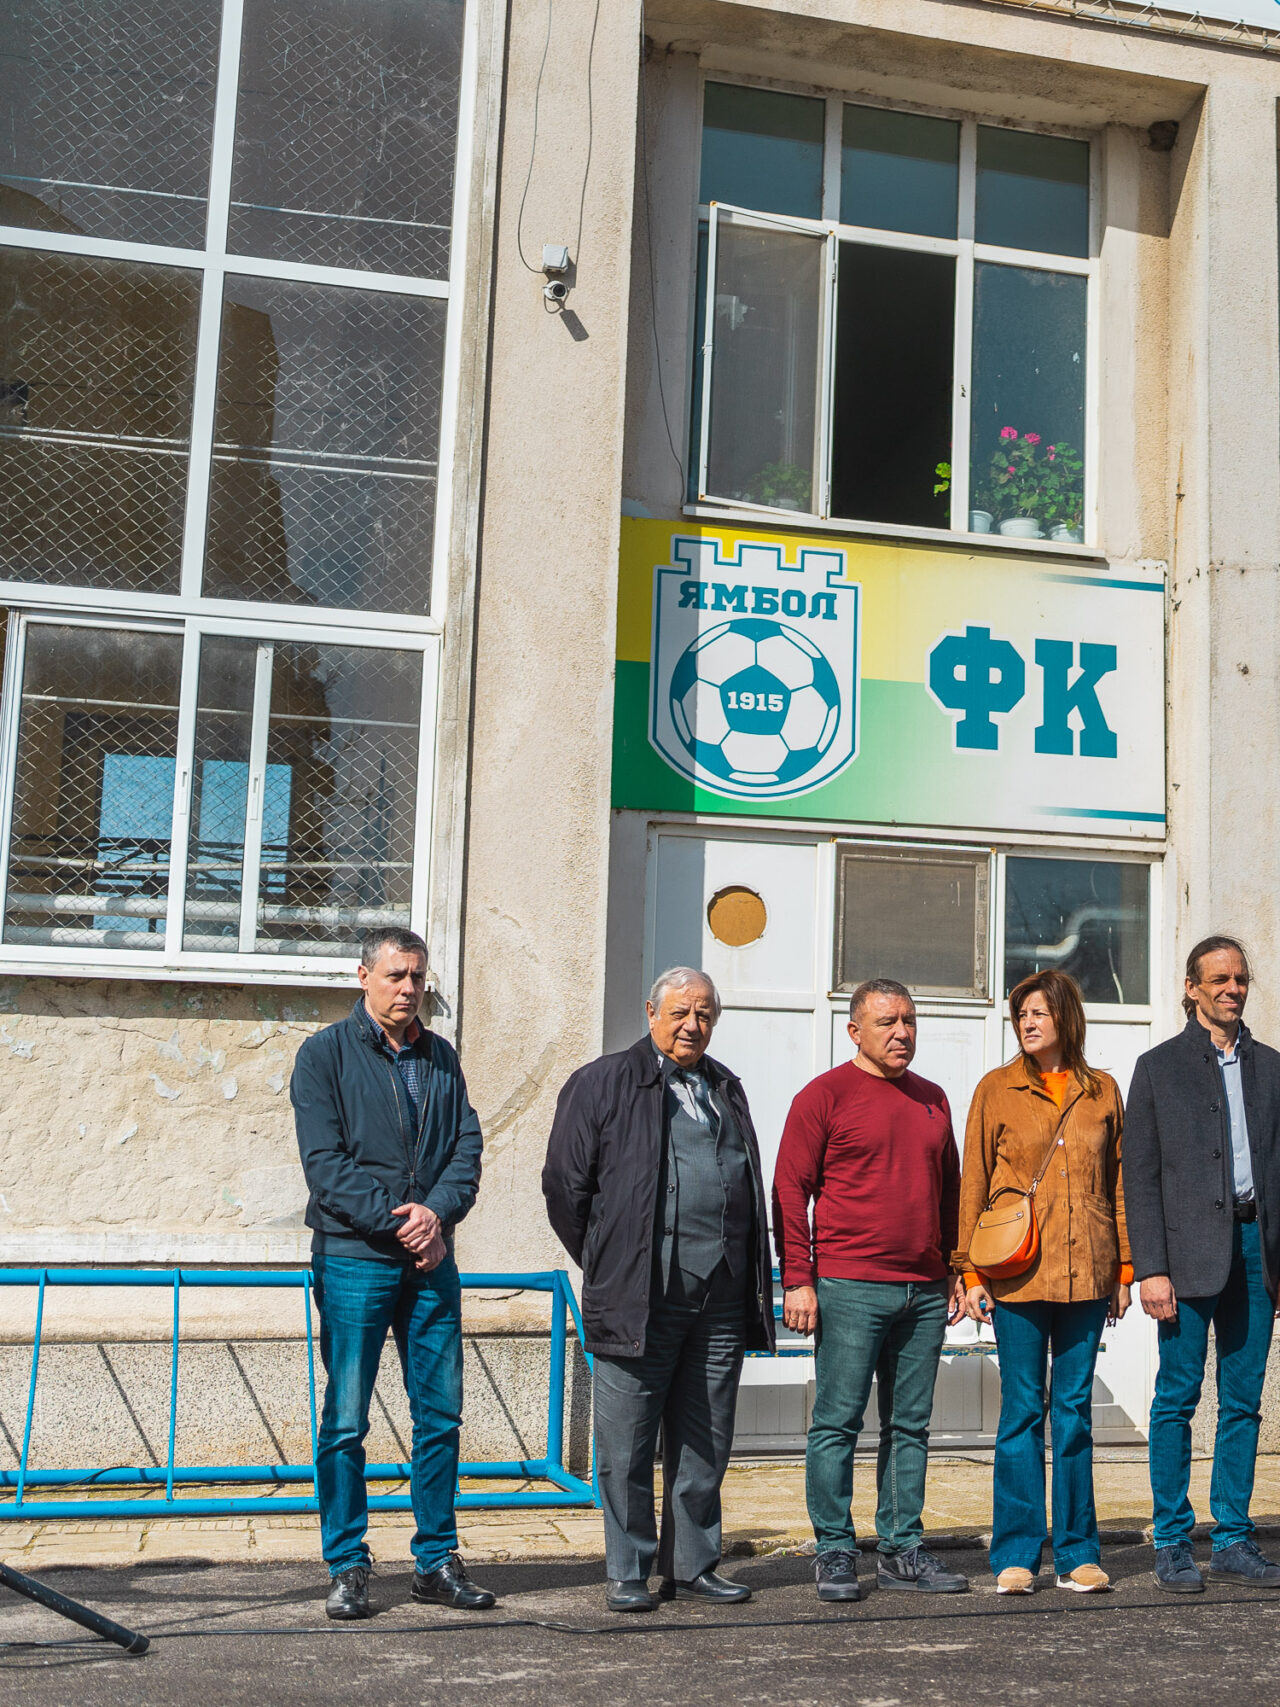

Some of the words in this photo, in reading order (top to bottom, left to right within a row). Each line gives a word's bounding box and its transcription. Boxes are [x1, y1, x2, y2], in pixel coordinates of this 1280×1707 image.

[678, 580, 838, 621] ЯМБОЛ
[727, 690, 784, 712] 1915
[929, 625, 1118, 759] ФК
